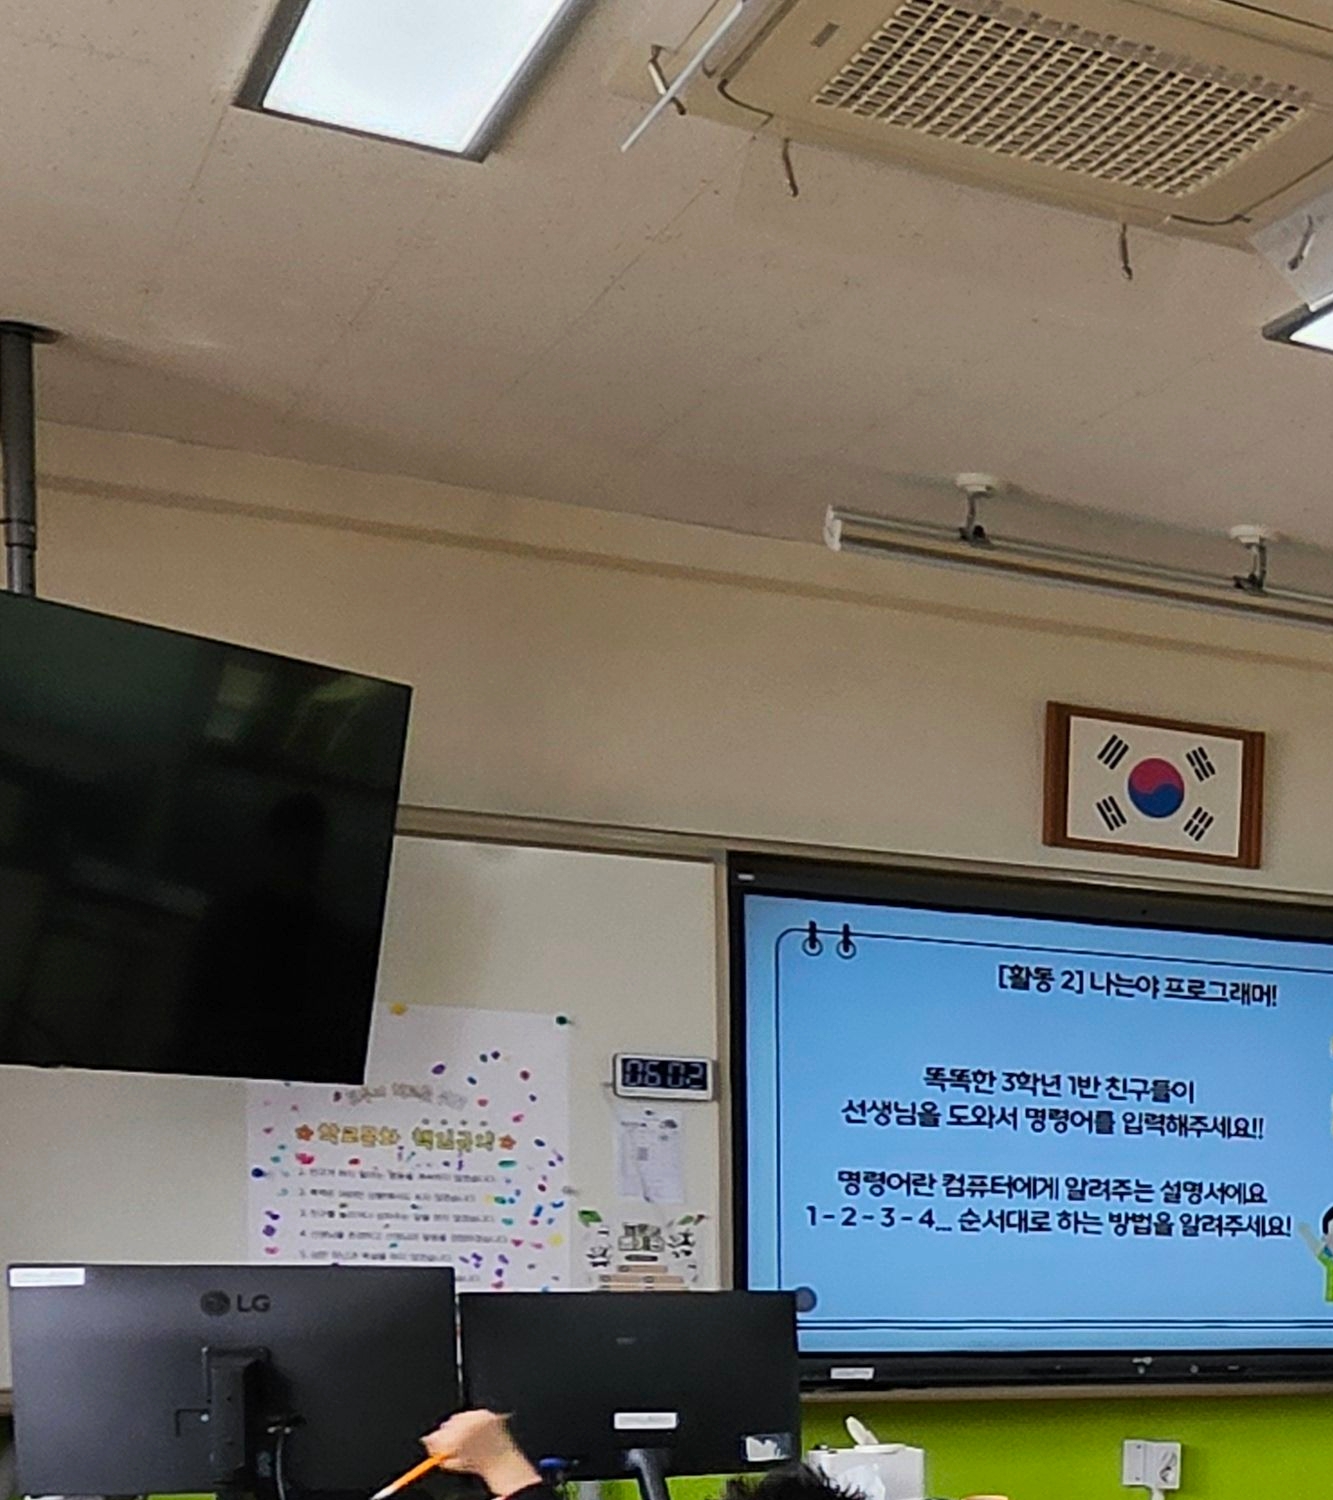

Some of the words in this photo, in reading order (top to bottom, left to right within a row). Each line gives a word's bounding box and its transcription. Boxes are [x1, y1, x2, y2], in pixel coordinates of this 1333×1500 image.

[998, 964, 1055, 993] [활동
[1060, 969, 1084, 995] 2]
[1090, 971, 1160, 1000] 나는야
[1164, 977, 1278, 1008] 프로그래머!
[924, 1067, 997, 1095] 똑똑한
[1001, 1070, 1062, 1099] 3학년
[1067, 1075, 1101, 1099] 1반
[1105, 1076, 1194, 1104] 친구들이
[841, 1099, 942, 1127] 선생님을
[946, 1104, 1018, 1131] 도와서
[1025, 1107, 1115, 1135] 명령어를
[1122, 1111, 1265, 1140] 입력해주세요!!
[838, 1170, 938, 1197] 명령어란
[942, 1173, 1060, 1200] 컴퓨터에게
[1064, 1176, 1155, 1203] 알려주는
[1160, 1180, 1268, 1205] 설명서에요
[958, 1208, 1052, 1233] 순서대로
[1056, 1210, 1104, 1235] 하는
[1108, 1211, 1174, 1237] 방법을
[1179, 1213, 1292, 1237] 알려주세요!
[236, 1293, 271, 1313] LG
